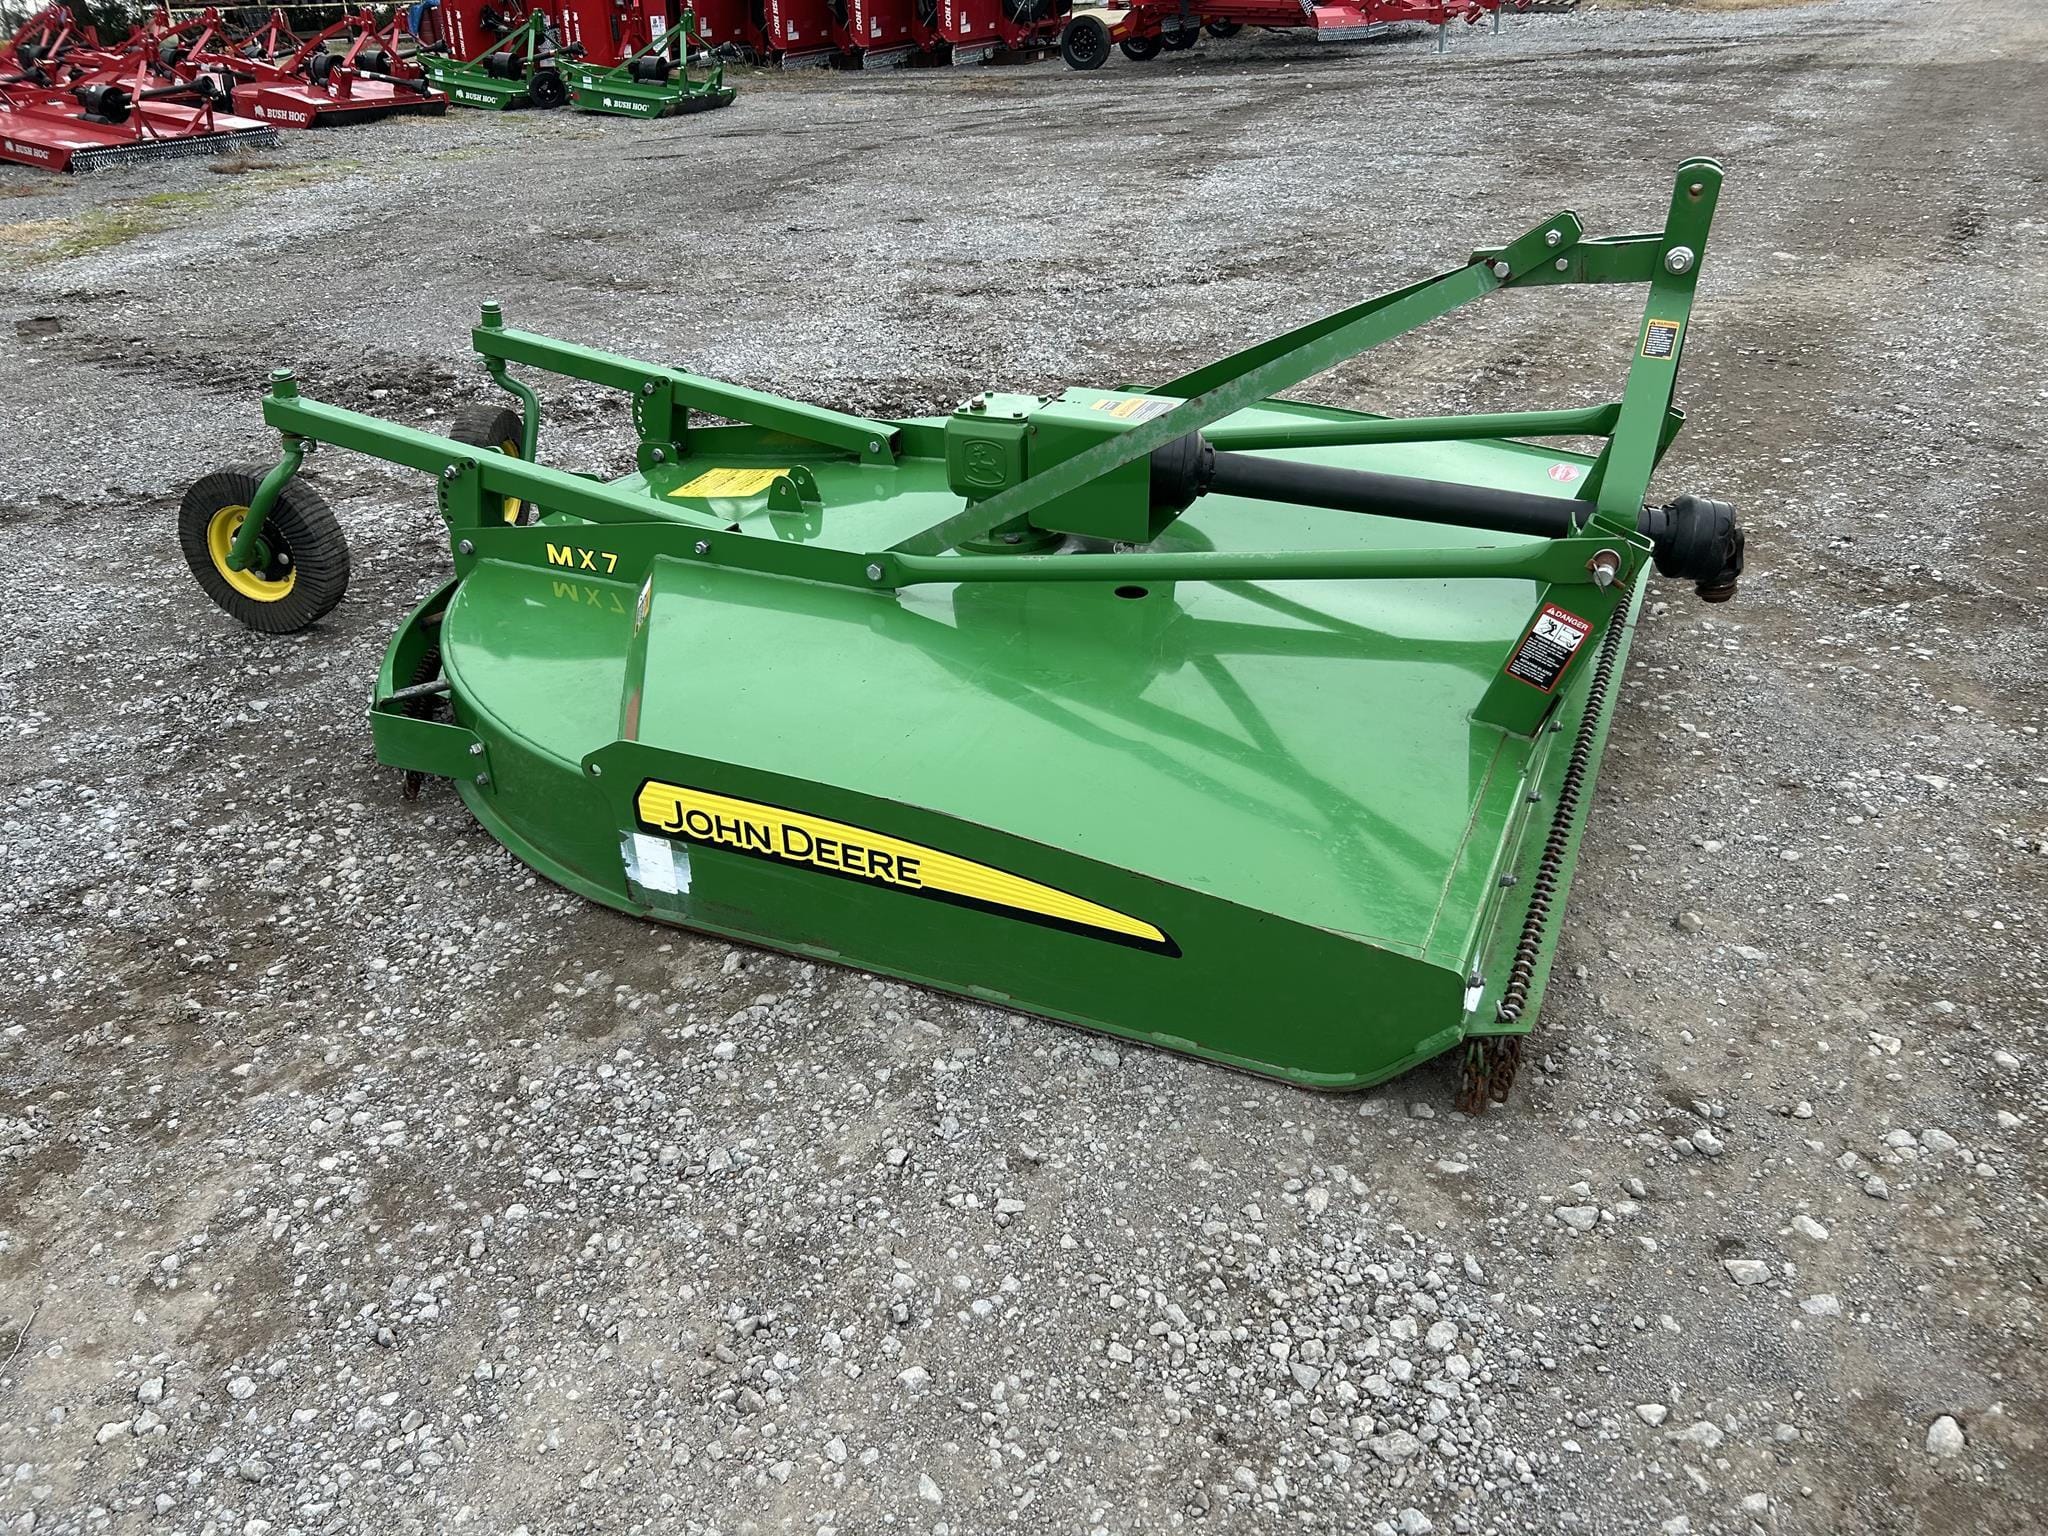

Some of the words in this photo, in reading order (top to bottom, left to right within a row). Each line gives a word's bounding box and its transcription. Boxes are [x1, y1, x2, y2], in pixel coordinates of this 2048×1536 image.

[465, 92, 482, 102] BUSH
[482, 95, 496, 103] HOG
[614, 100, 631, 109] BUSH
[632, 103, 647, 111] HOG
[267, 108, 287, 120] BUSH
[288, 111, 305, 122] HOG
[15, 144, 33, 156] BUSH
[33, 148, 48, 160] HOG
[546, 542, 618, 574] MX7
[1555, 610, 1589, 630] DANGER
[664, 800, 772, 850] JOHN
[781, 824, 923, 886] DEERE
